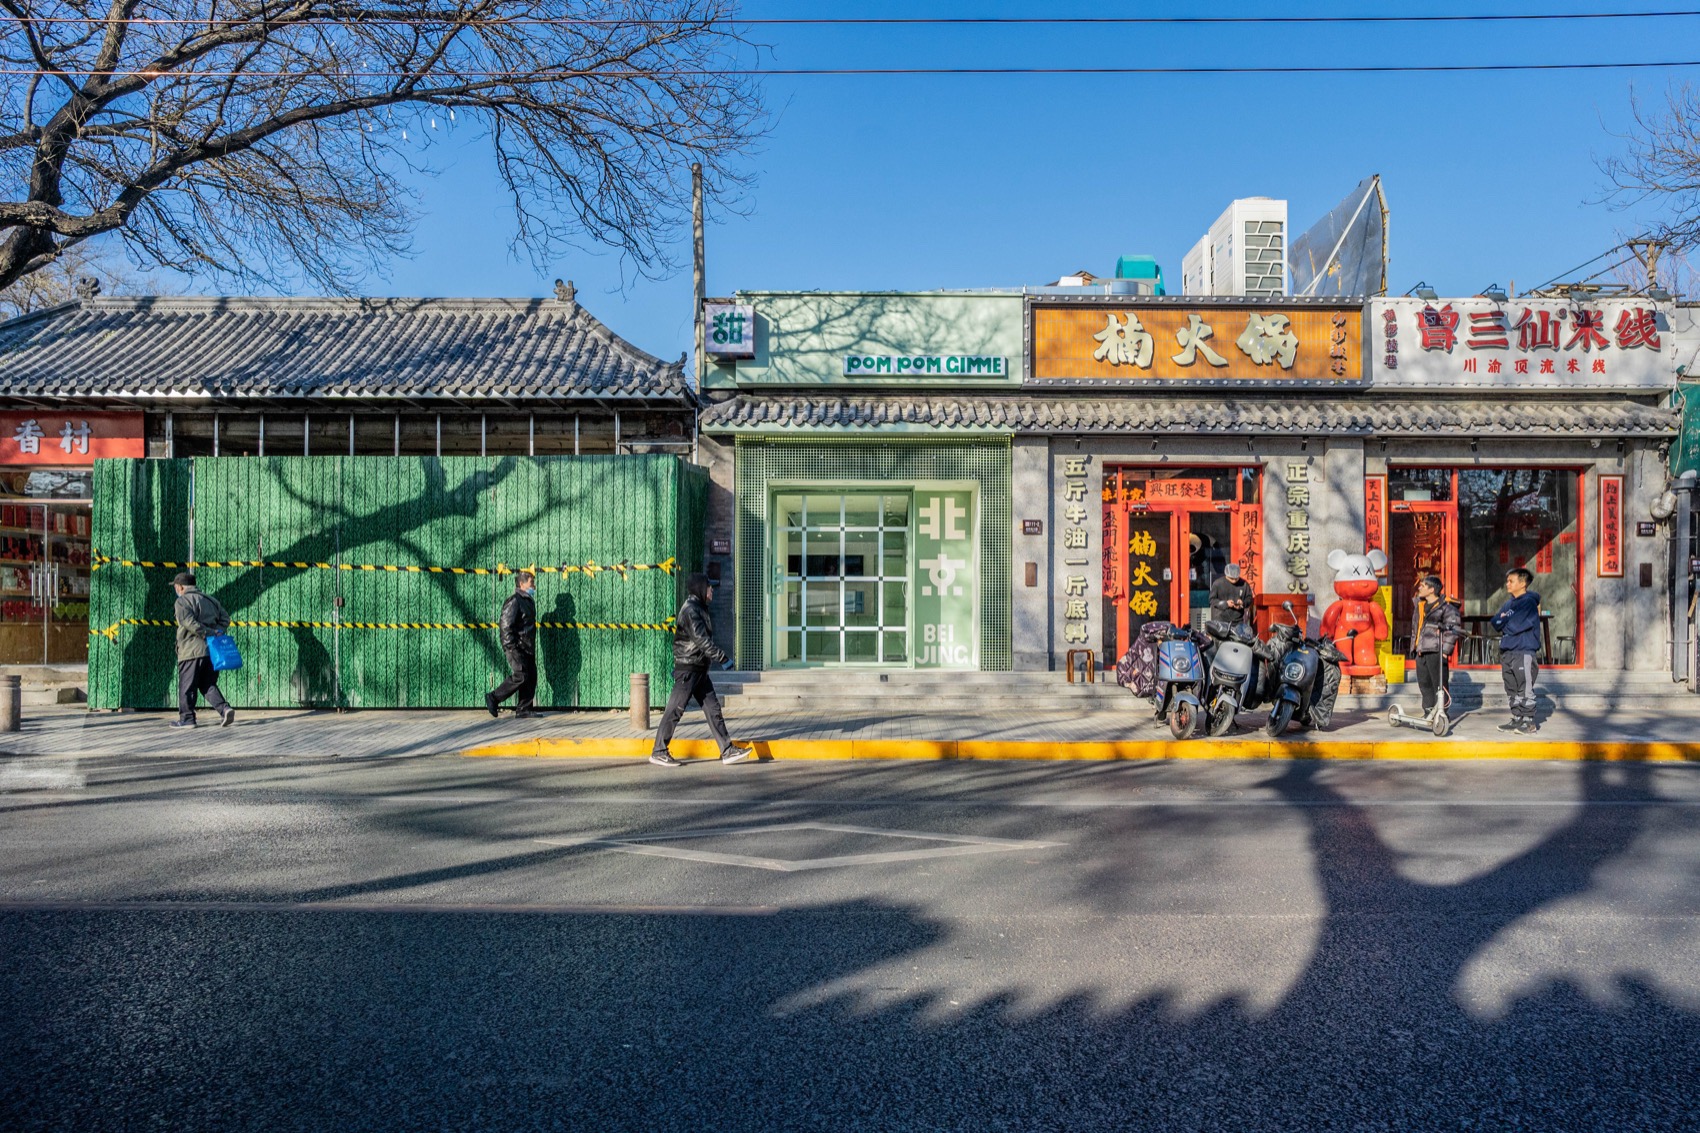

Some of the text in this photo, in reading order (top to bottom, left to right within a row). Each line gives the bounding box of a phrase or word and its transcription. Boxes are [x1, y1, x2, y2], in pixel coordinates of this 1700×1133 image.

[1093, 312, 1299, 369] 楠火锅
[847, 356, 1001, 373] POM POM GIMME
[1463, 357, 1606, 375] 川渝顶流米线
[13, 419, 92, 454] 香村
[919, 497, 966, 596] 北京
[1065, 458, 1088, 643] 五斤牛油一斤底料
[1129, 530, 1158, 617] 楠火锅
[924, 624, 954, 643] BEI
[915, 645, 969, 665] JING
